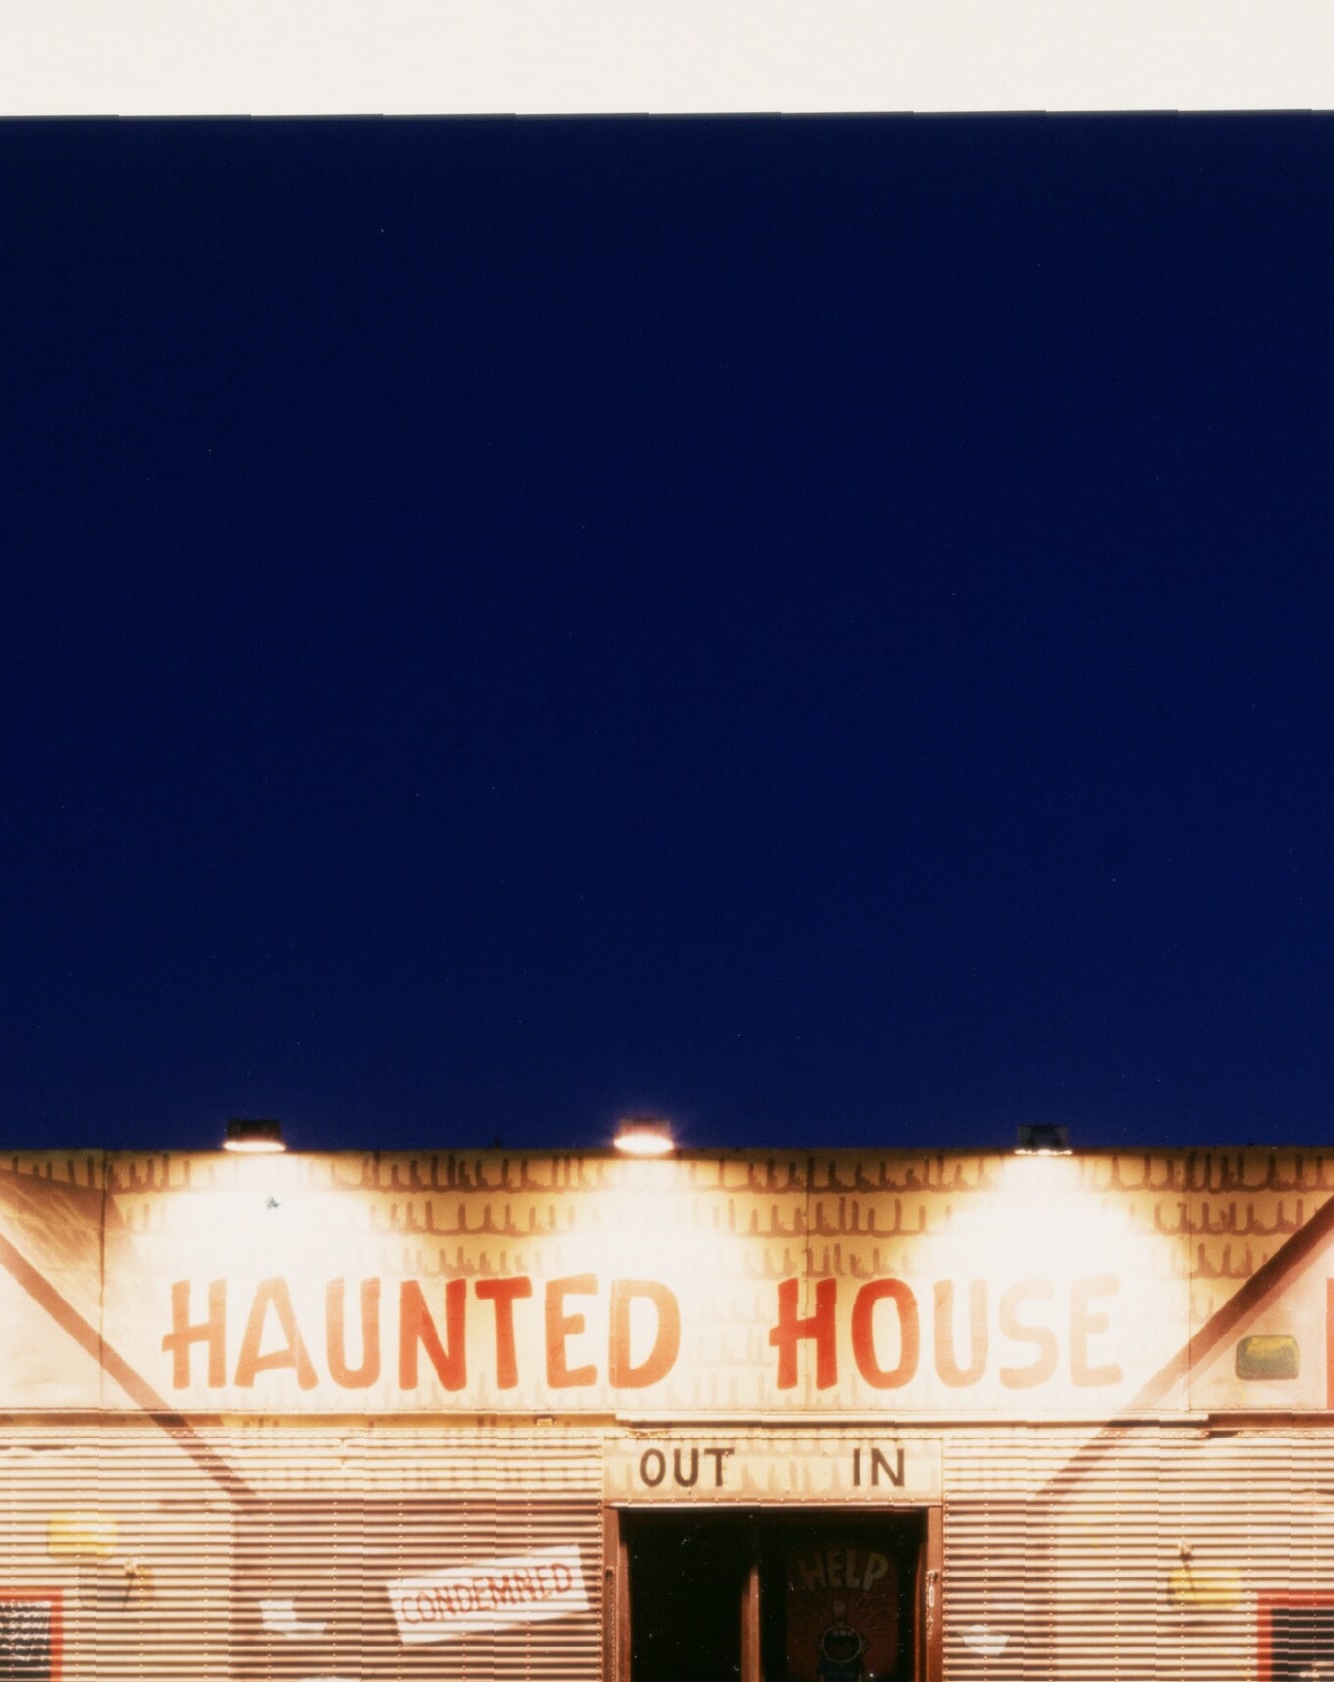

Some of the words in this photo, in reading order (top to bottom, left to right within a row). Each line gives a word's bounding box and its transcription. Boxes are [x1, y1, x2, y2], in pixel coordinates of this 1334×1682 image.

[162, 1273, 681, 1391] HAUNTED
[769, 1274, 1123, 1391] HOUSE
[639, 1448, 735, 1488] OUT
[852, 1448, 906, 1488] IN
[797, 1547, 890, 1593] HELP
[401, 1563, 572, 1624] CONDEMNED
